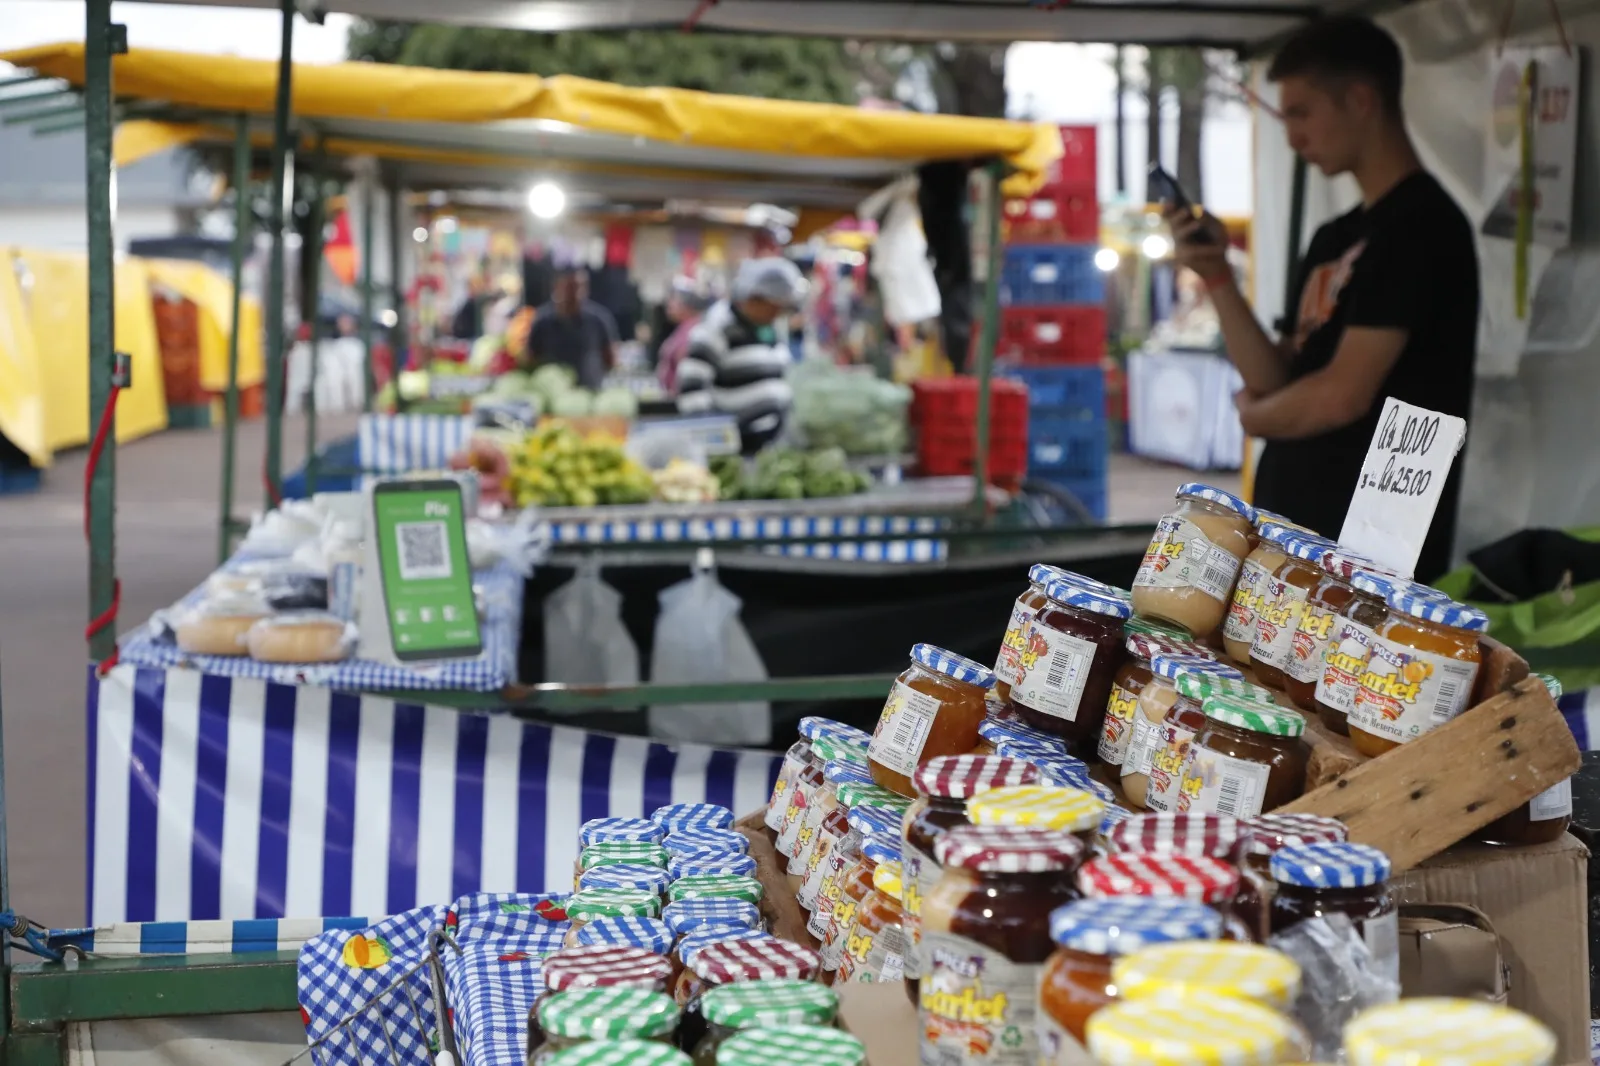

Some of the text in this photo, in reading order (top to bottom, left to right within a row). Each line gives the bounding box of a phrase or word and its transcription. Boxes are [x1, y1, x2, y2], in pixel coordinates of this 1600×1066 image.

[1346, 624, 1370, 646] DOCE
[1374, 642, 1404, 667] DOCES
[1359, 672, 1421, 704] arlet
